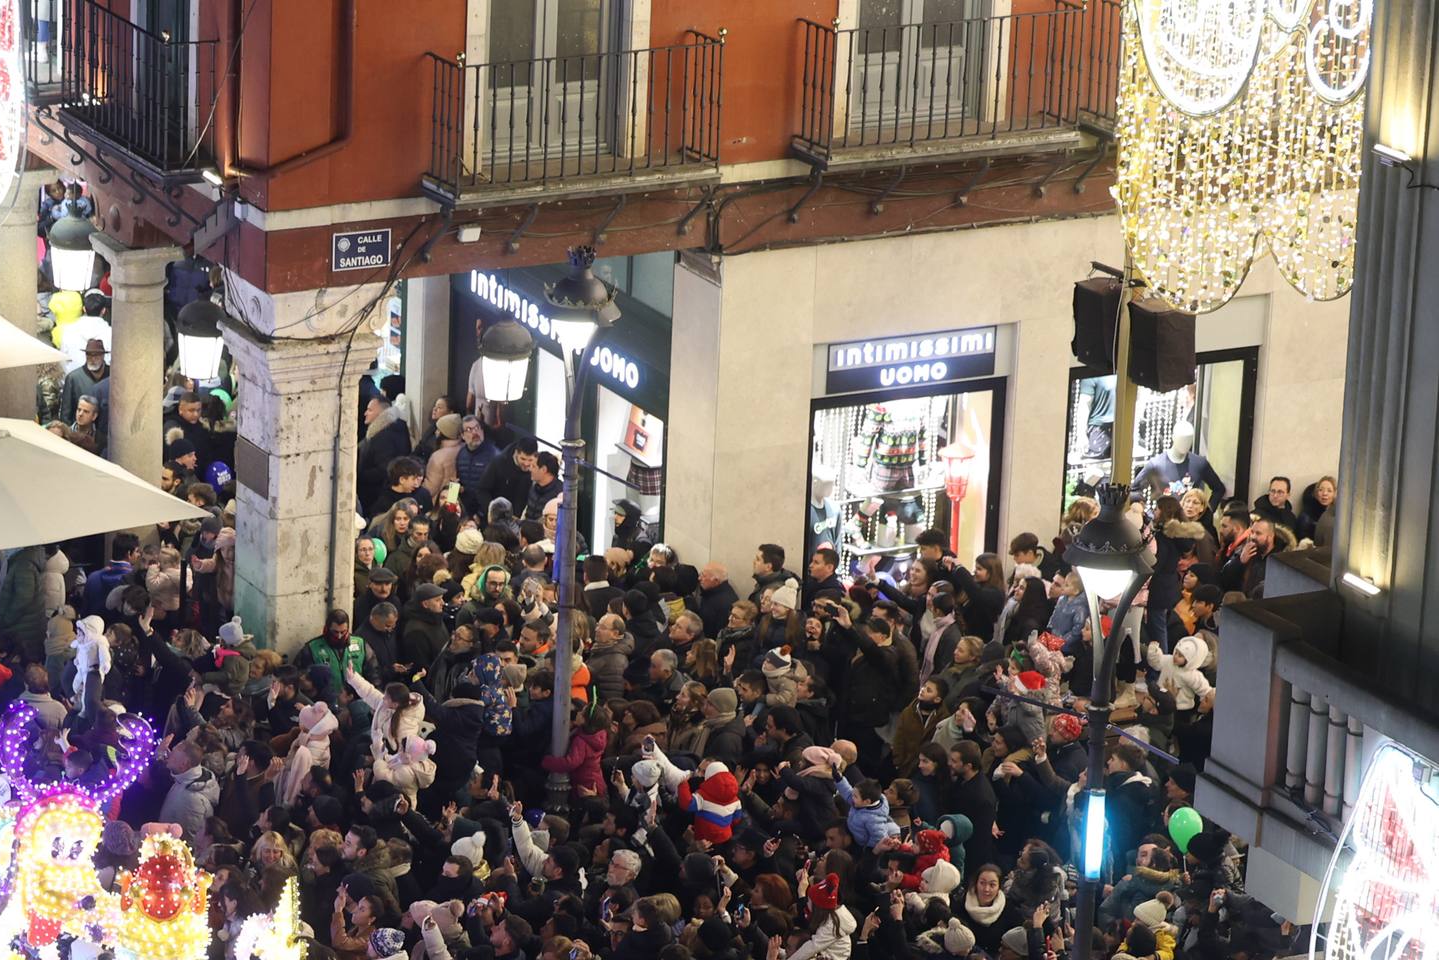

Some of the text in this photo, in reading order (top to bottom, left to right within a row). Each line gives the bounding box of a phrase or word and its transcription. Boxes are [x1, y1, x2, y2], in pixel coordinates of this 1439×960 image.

[357, 234, 382, 244] CALLE
[339, 254, 383, 267] SANTIAGO
[837, 332, 993, 367] intimissimi
[880, 361, 948, 386] UOMO
